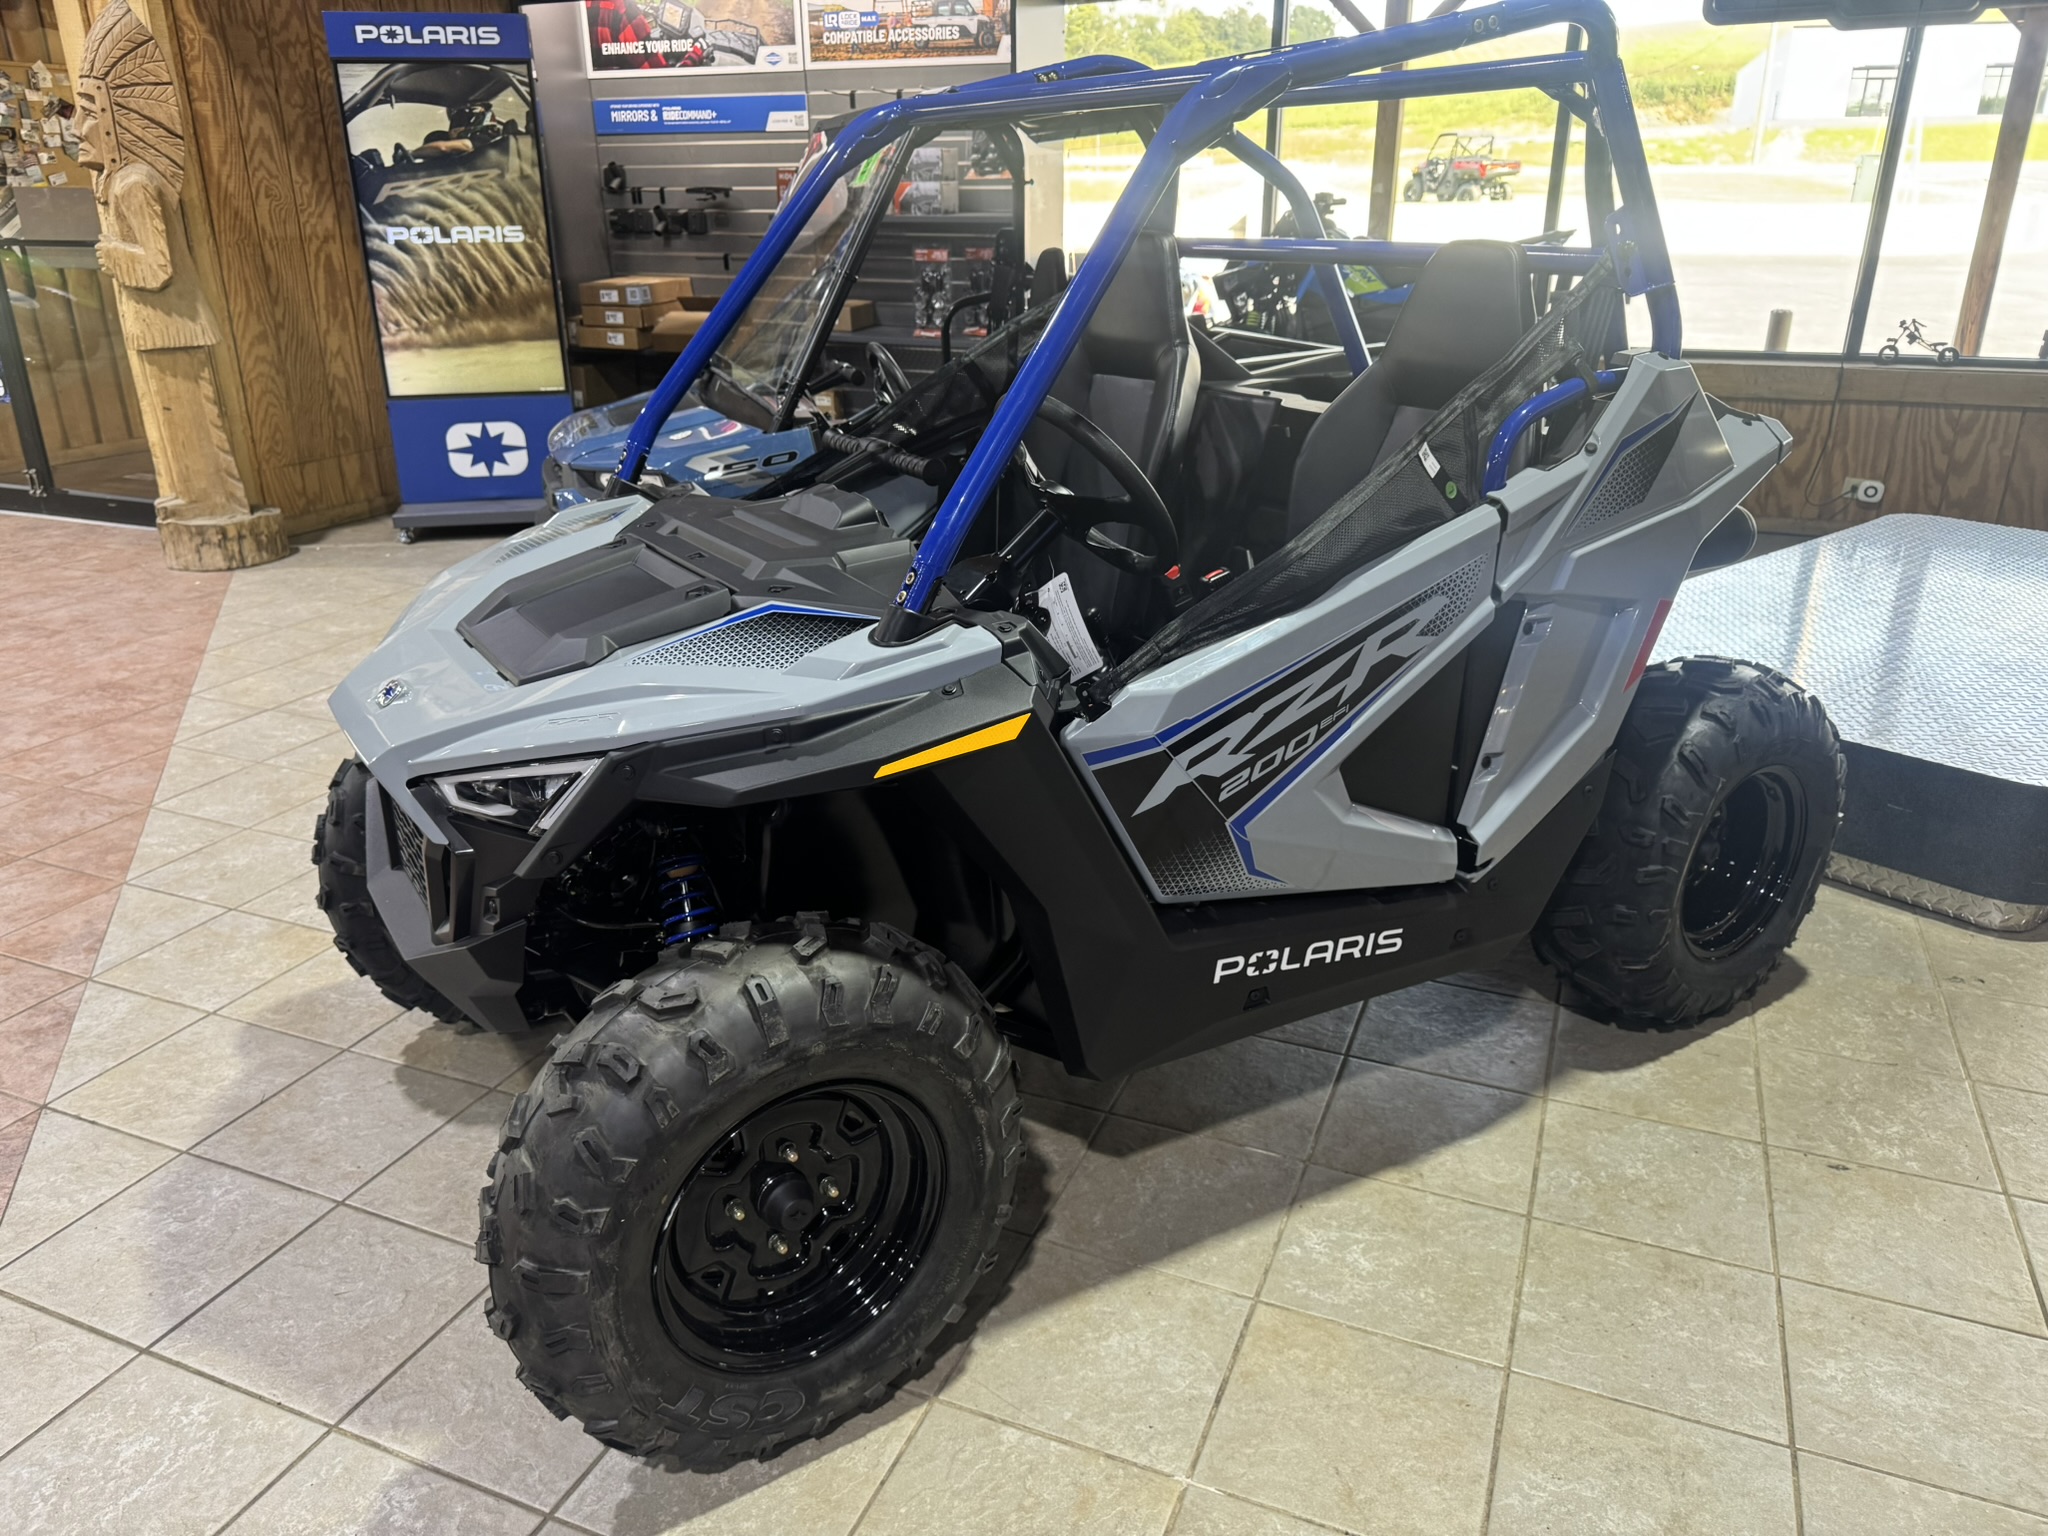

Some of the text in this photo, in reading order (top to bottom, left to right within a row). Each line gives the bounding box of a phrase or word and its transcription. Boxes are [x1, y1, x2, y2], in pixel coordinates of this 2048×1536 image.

[355, 24, 501, 45] POLARIS
[823, 26, 960, 45] COMPATIBLE ACCESSORIES
[602, 39, 694, 55] ENHANCE YOUR RIDE
[611, 110, 649, 122] MIRRORS
[650, 110, 658, 122] &
[386, 225, 525, 244] POLARIS
[1131, 594, 1451, 817] RZR
[1218, 704, 1349, 803] 200 EFI
[1213, 928, 1404, 984] POLARIS
